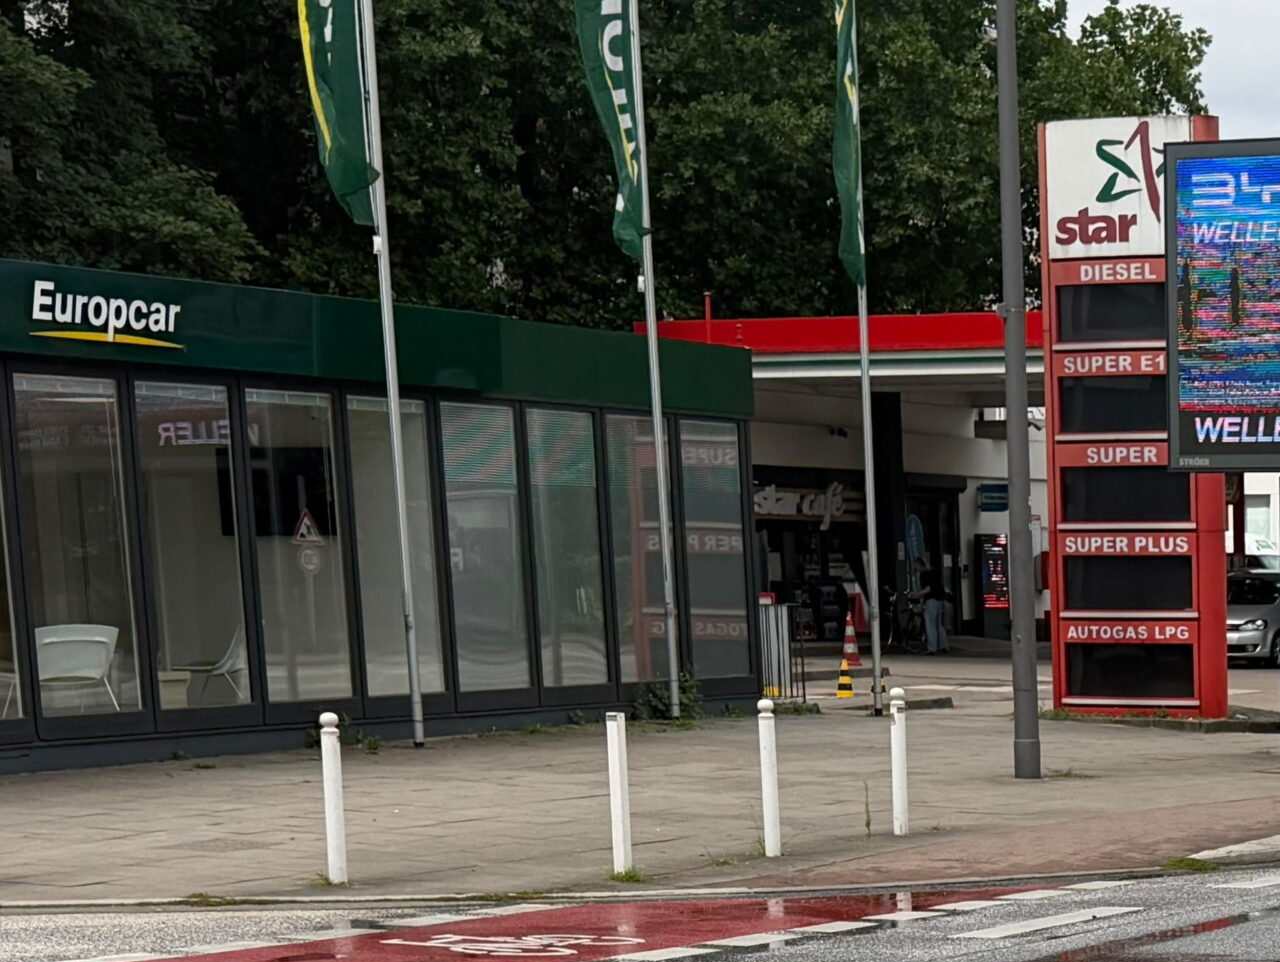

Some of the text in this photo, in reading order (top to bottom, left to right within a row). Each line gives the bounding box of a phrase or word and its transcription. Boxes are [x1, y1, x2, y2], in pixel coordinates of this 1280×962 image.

[1056, 207, 1137, 246] star
[1080, 263, 1157, 282] DIESEL
[32, 279, 181, 342] Europcar
[1063, 354, 1165, 374] SUPER E1
[1087, 446, 1158, 464] SUPER
[753, 480, 846, 531] star café
[1065, 536, 1189, 553] SUPER PLUS
[1067, 626, 1189, 640] AUTOGAS LPG
